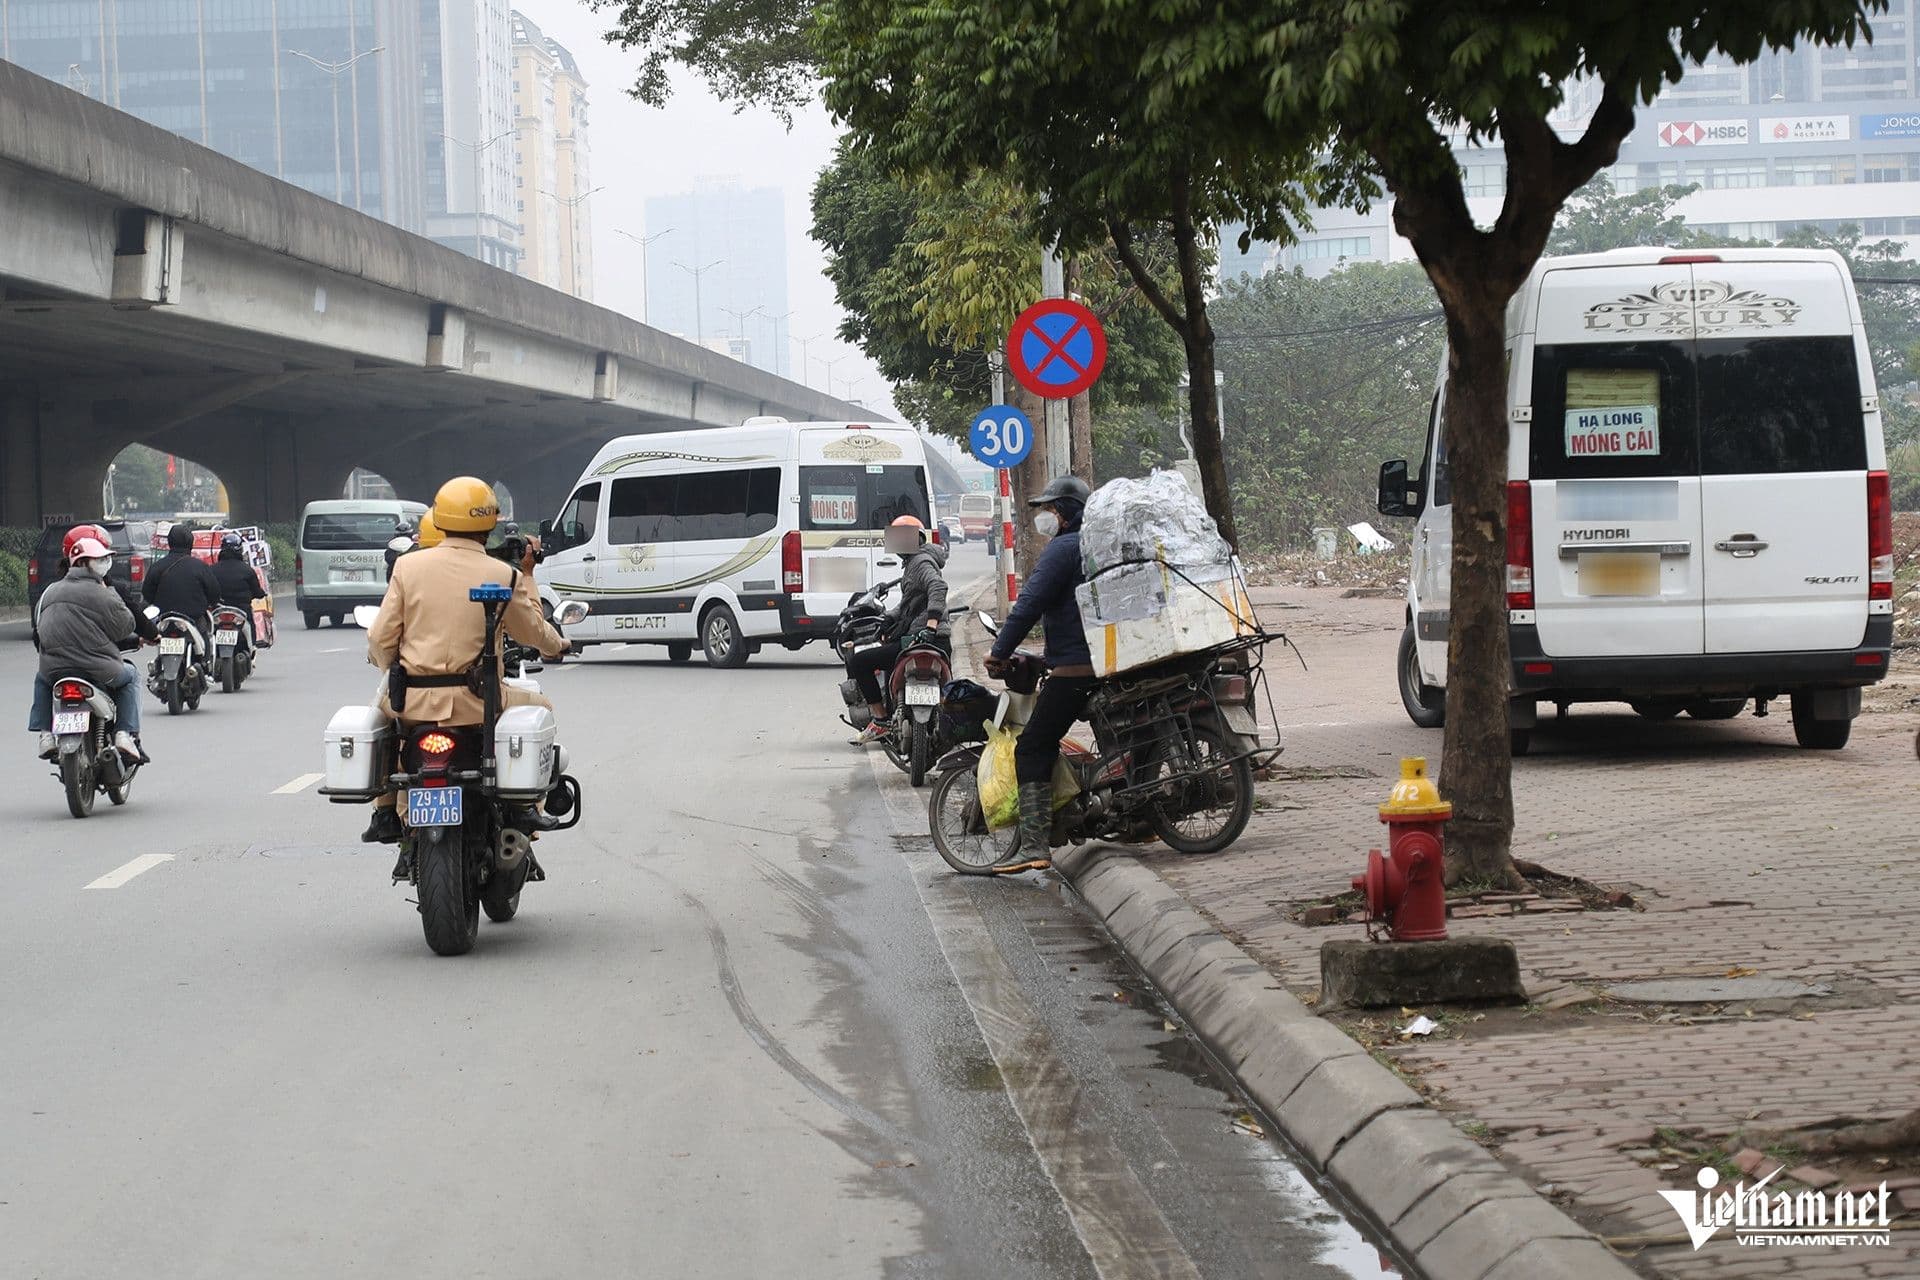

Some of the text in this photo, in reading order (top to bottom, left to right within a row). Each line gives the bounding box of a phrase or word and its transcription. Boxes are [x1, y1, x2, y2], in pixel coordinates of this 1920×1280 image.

[1707, 125, 1747, 139] HSBC
[1670, 288, 1716, 302] VIP
[1584, 308, 1802, 330] LUXURY
[1603, 412, 1643, 427] LONG
[978, 417, 1024, 456] 30
[1571, 426, 1654, 455] MÓNG CÁI
[1563, 528, 1630, 541] HYUNDAI
[846, 538, 885, 547] SOLA
[614, 616, 666, 630] SOLATI
[416, 789, 454, 807] 29-A1
[411, 806, 459, 824] 007.06
